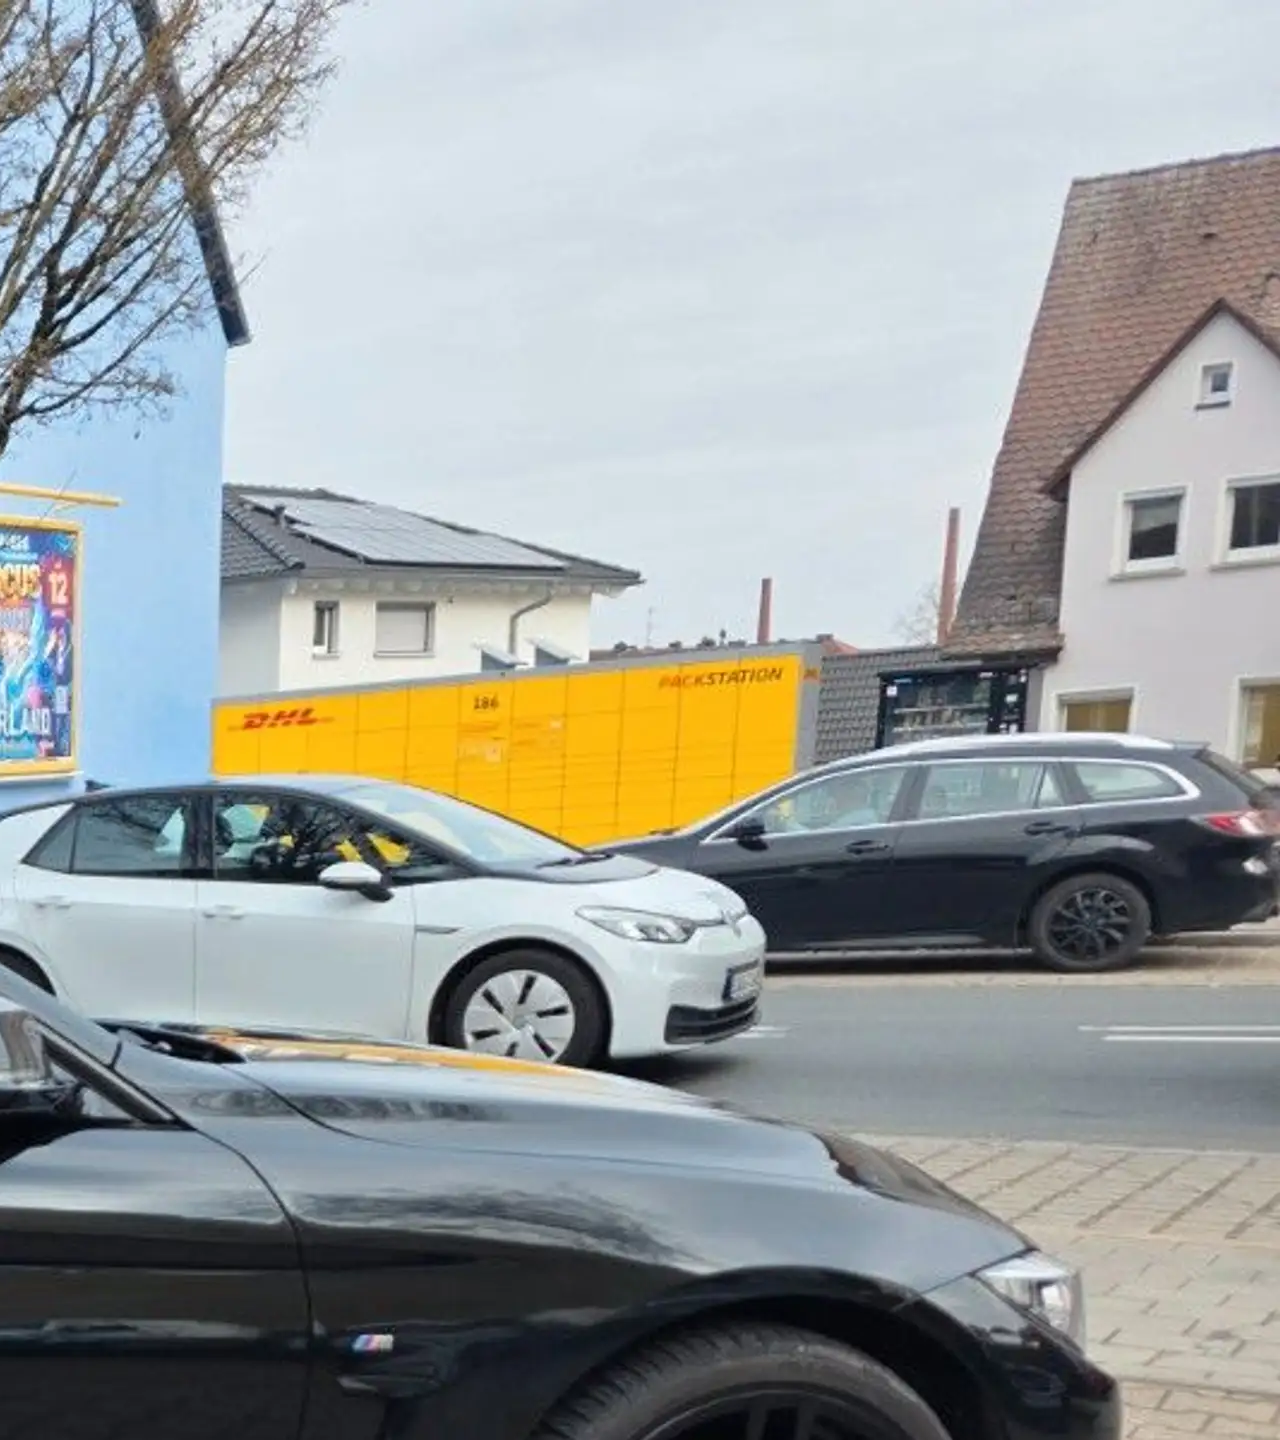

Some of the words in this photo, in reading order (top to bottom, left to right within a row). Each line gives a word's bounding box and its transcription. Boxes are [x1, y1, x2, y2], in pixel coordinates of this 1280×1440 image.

[49, 571, 69, 604] 12
[658, 667, 784, 690] PACKSTATION
[242, 707, 319, 731] DHL
